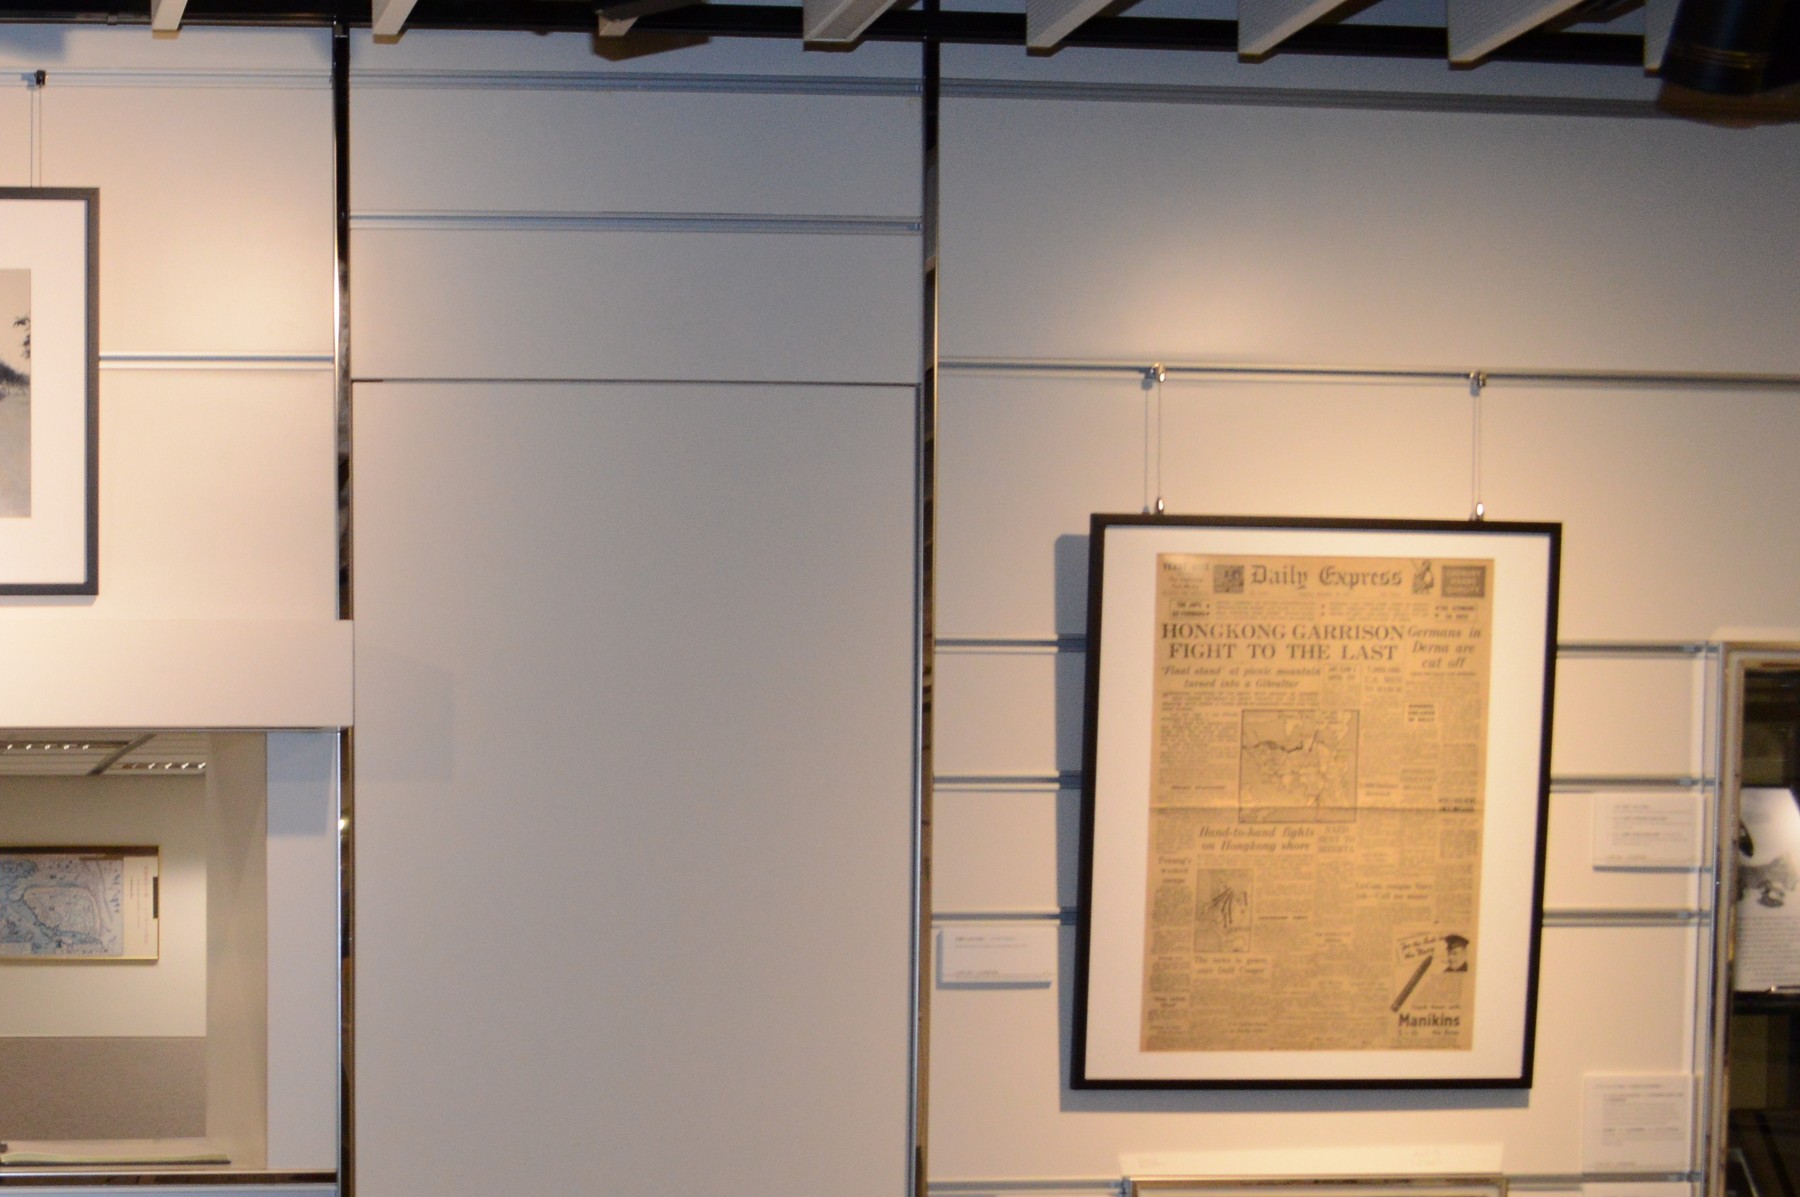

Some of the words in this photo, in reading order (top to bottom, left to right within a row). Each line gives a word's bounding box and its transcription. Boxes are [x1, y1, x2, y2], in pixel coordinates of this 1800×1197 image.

[1250, 564, 1308, 590] Daily
[1319, 563, 1403, 591] Express
[1161, 623, 1286, 640] HONGKONG
[1292, 624, 1403, 641] GARRISON
[1407, 626, 1462, 639] Germans
[1469, 626, 1481, 639] in
[1169, 642, 1237, 659] FIGHT
[1247, 643, 1276, 659] TO
[1286, 643, 1331, 660] THE
[1340, 644, 1398, 661] LAST
[1412, 640, 1449, 653] Derna
[1454, 644, 1475, 653] are
[1421, 657, 1441, 669] cut
[1448, 656, 1467, 669] off
[1399, 1013, 1460, 1027] Manikins
